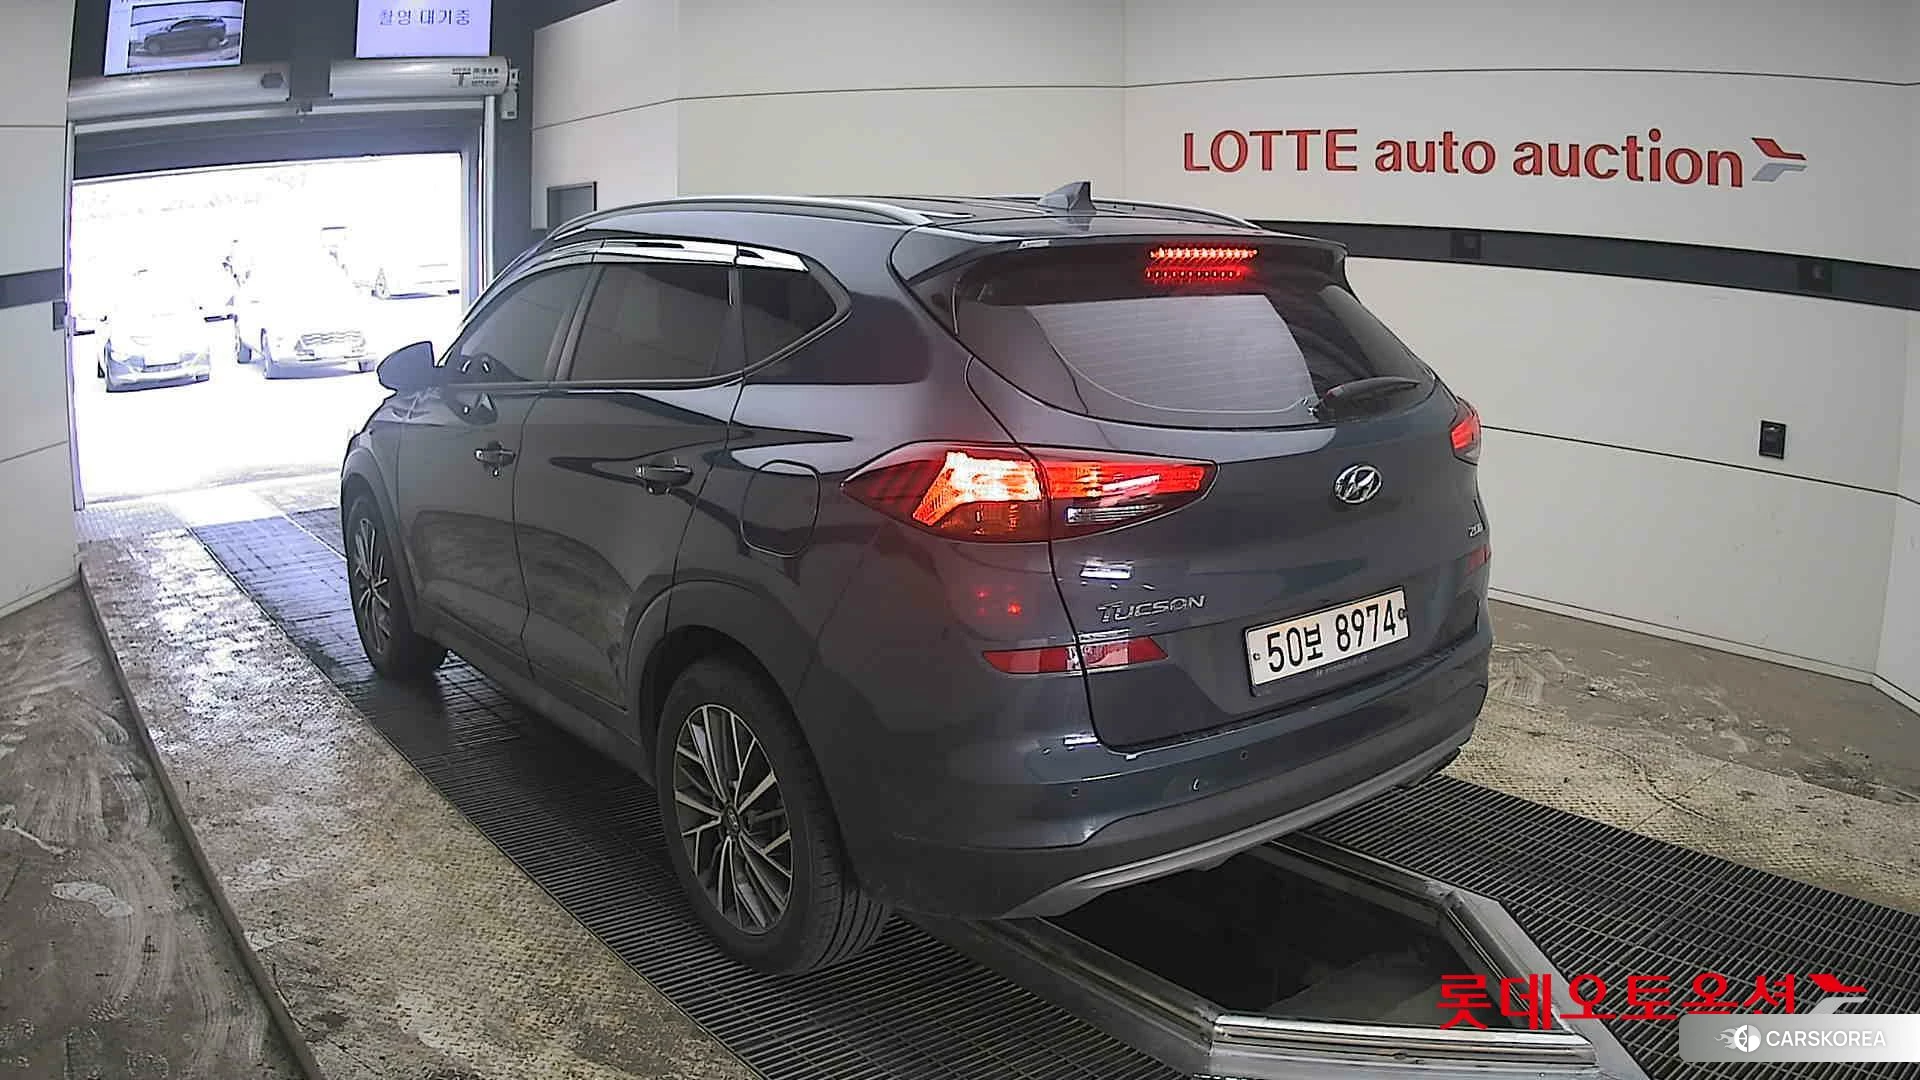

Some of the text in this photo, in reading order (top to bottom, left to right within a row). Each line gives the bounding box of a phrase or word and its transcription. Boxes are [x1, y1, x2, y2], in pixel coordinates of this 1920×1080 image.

[420, 9, 471, 26] 대기중
[1184, 128, 1745, 188] LOTTE auto auction
[1097, 595, 1205, 622] TUCSON
[1265, 623, 1324, 673] 50보
[1335, 599, 1397, 652] 8974
